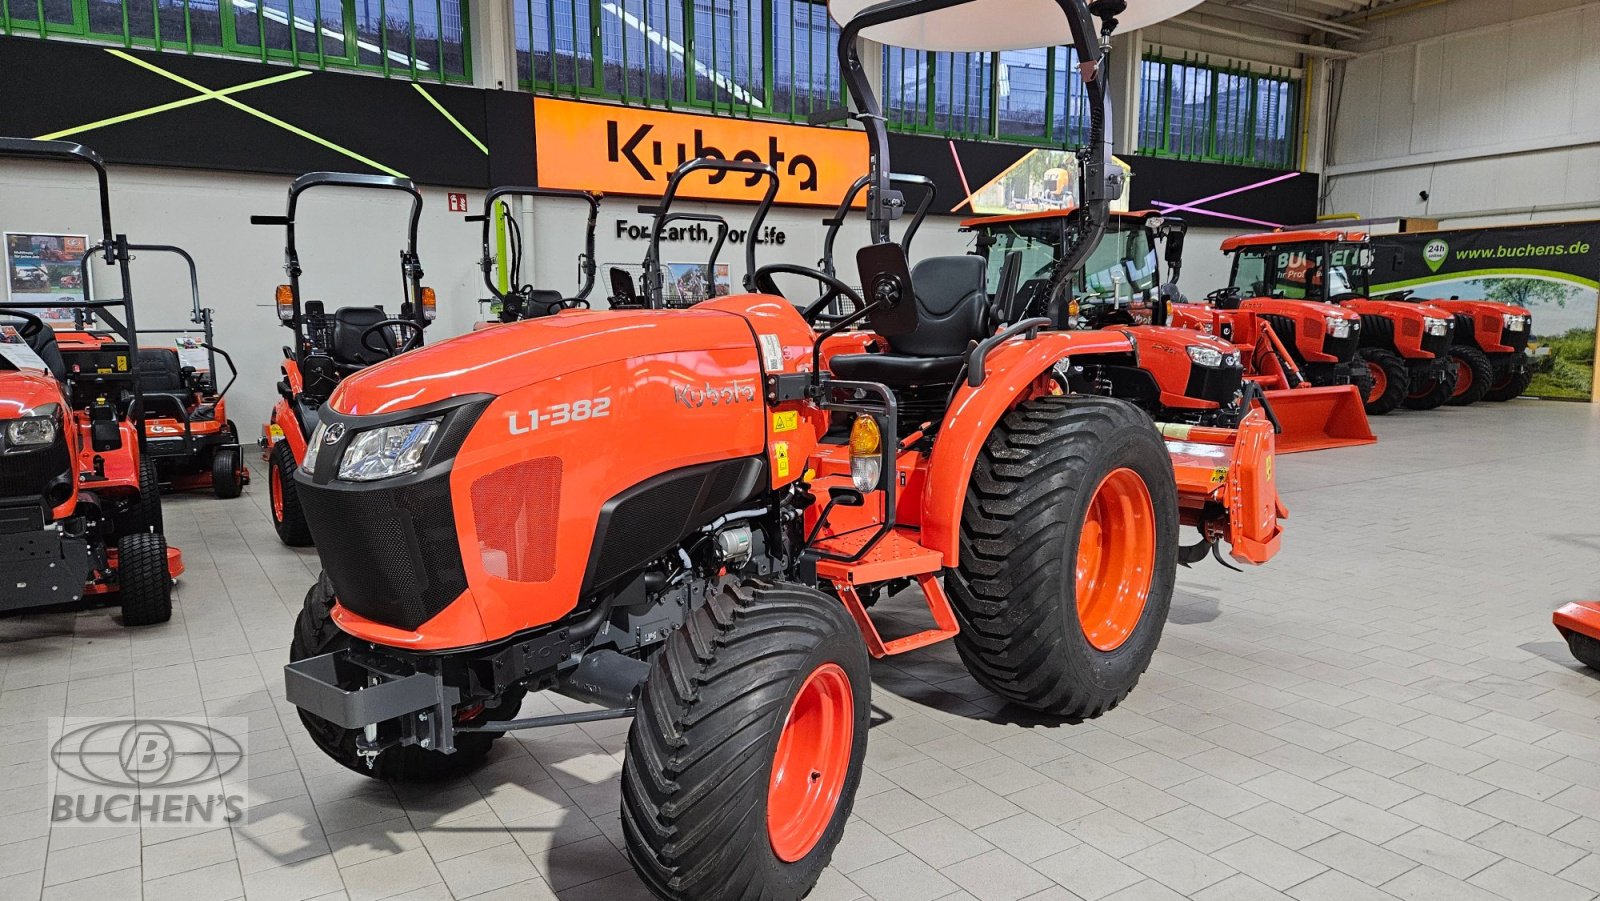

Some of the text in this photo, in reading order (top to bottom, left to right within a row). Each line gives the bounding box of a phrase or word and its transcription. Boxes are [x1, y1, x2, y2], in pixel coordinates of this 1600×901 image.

[607, 120, 817, 191] Kubota
[616, 219, 650, 239] For
[1428, 245, 1445, 253] 24h
[1456, 241, 1590, 260] www.buchens.de
[674, 380, 755, 409] Kubota
[509, 397, 611, 436] L1-382
